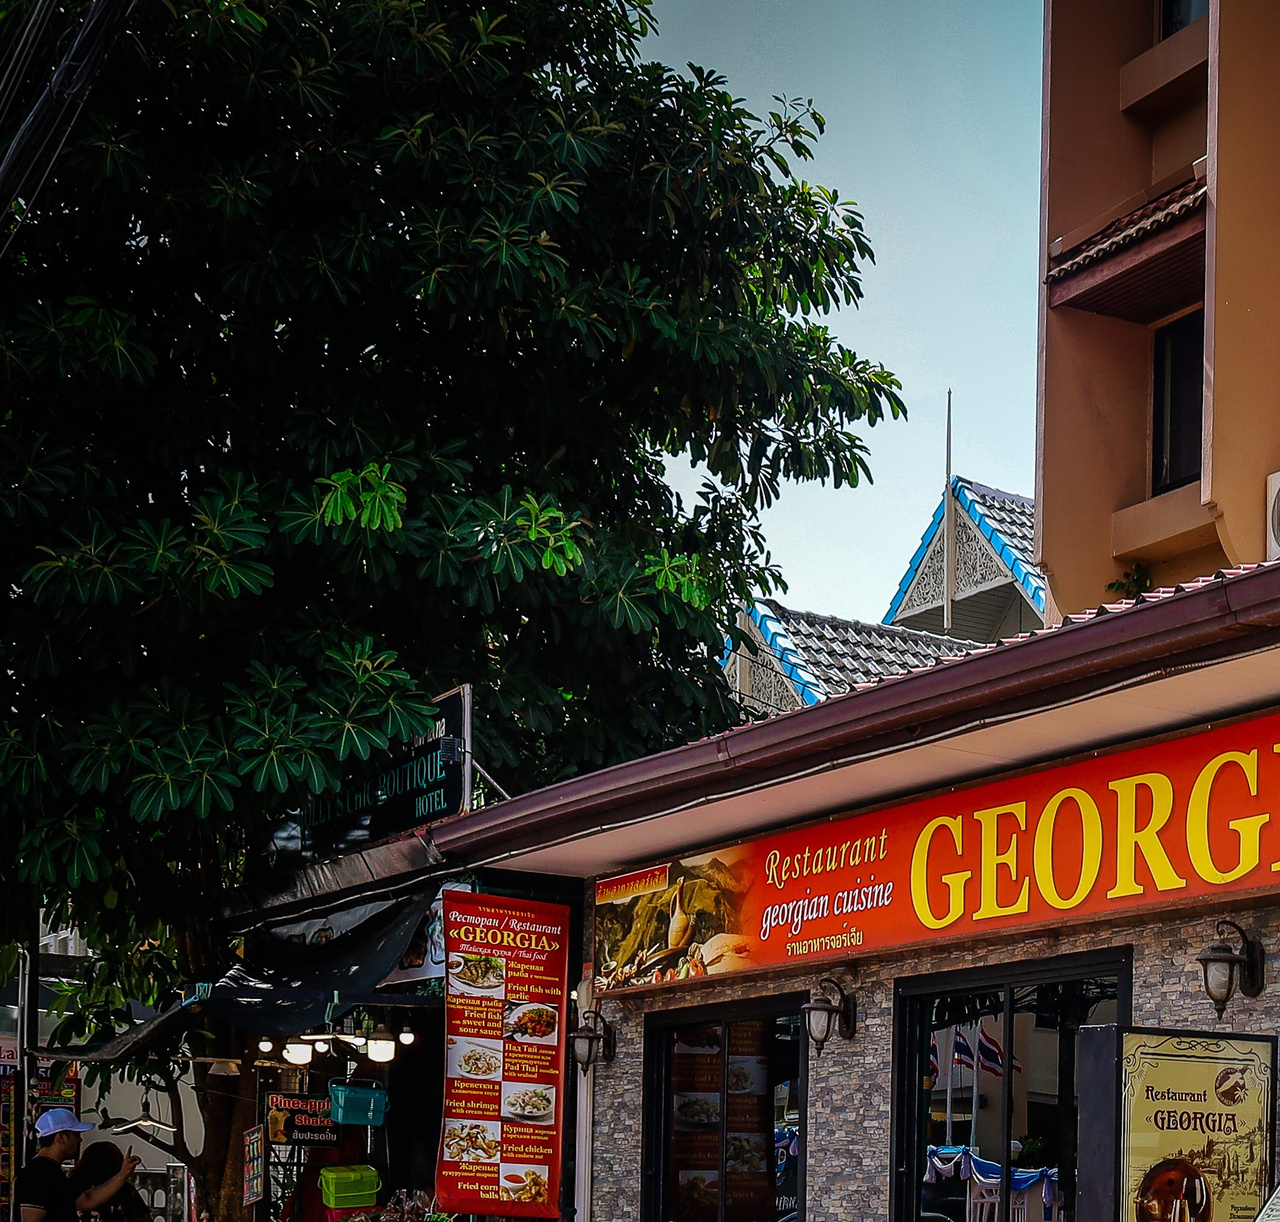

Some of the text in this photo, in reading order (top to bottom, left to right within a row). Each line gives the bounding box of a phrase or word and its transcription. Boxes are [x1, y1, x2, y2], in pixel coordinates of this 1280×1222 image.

[378, 750, 447, 798] BOUTIQUE
[415, 788, 448, 818] HOTEL
[765, 827, 889, 892] Restaurant
[760, 878, 894, 941] georgian cuisine
[449, 911, 499, 928] Ресторан
[509, 919, 562, 934] Restaurant
[449, 926, 560, 951] «GEORGIA»
[786, 923, 863, 956] ร้านอาหารจอร์เจีย
[508, 983, 561, 995] Fried fish with
[507, 992, 530, 1000] garlic
[464, 1010, 502, 1020] Fried fish
[462, 1019, 485, 1027] sweet
[487, 1020, 502, 1028] and
[521, 1064, 538, 1072] Thai
[1145, 1085, 1208, 1103] Restaurant
[269, 1095, 331, 1113] Pineappl
[466, 1101, 499, 1110] shrimps
[295, 1114, 334, 1126] Shake
[1145, 1109, 1247, 1135] «GEORGIA»
[503, 1124, 533, 1134] Курица
[503, 1144, 553, 1154] Fried chicken
[458, 1182, 499, 1191] Fried corn
[480, 1191, 499, 1199] balls
